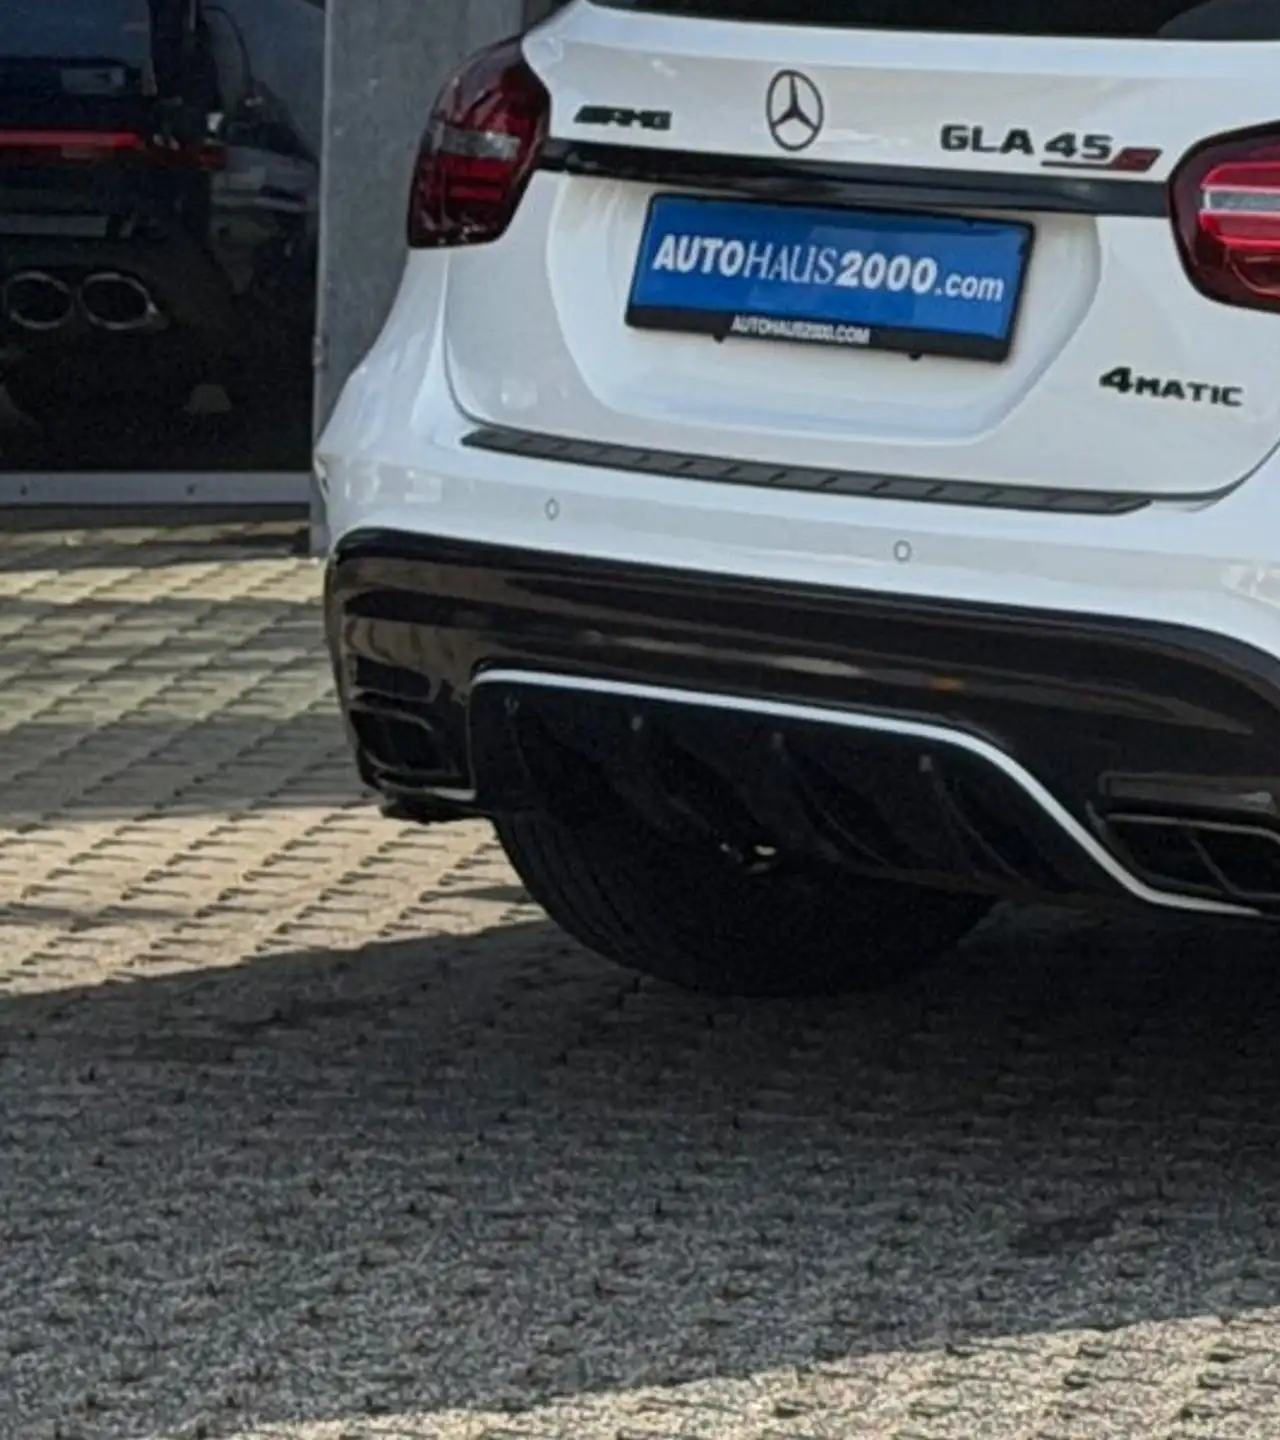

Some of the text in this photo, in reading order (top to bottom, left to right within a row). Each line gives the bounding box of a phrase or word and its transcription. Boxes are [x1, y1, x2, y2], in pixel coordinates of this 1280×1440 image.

[941, 124, 1034, 156] GLA
[1043, 132, 1113, 160] 45
[653, 234, 1005, 302] AUTOHAUS2000.com
[1099, 366, 1244, 407] 4MATIC
